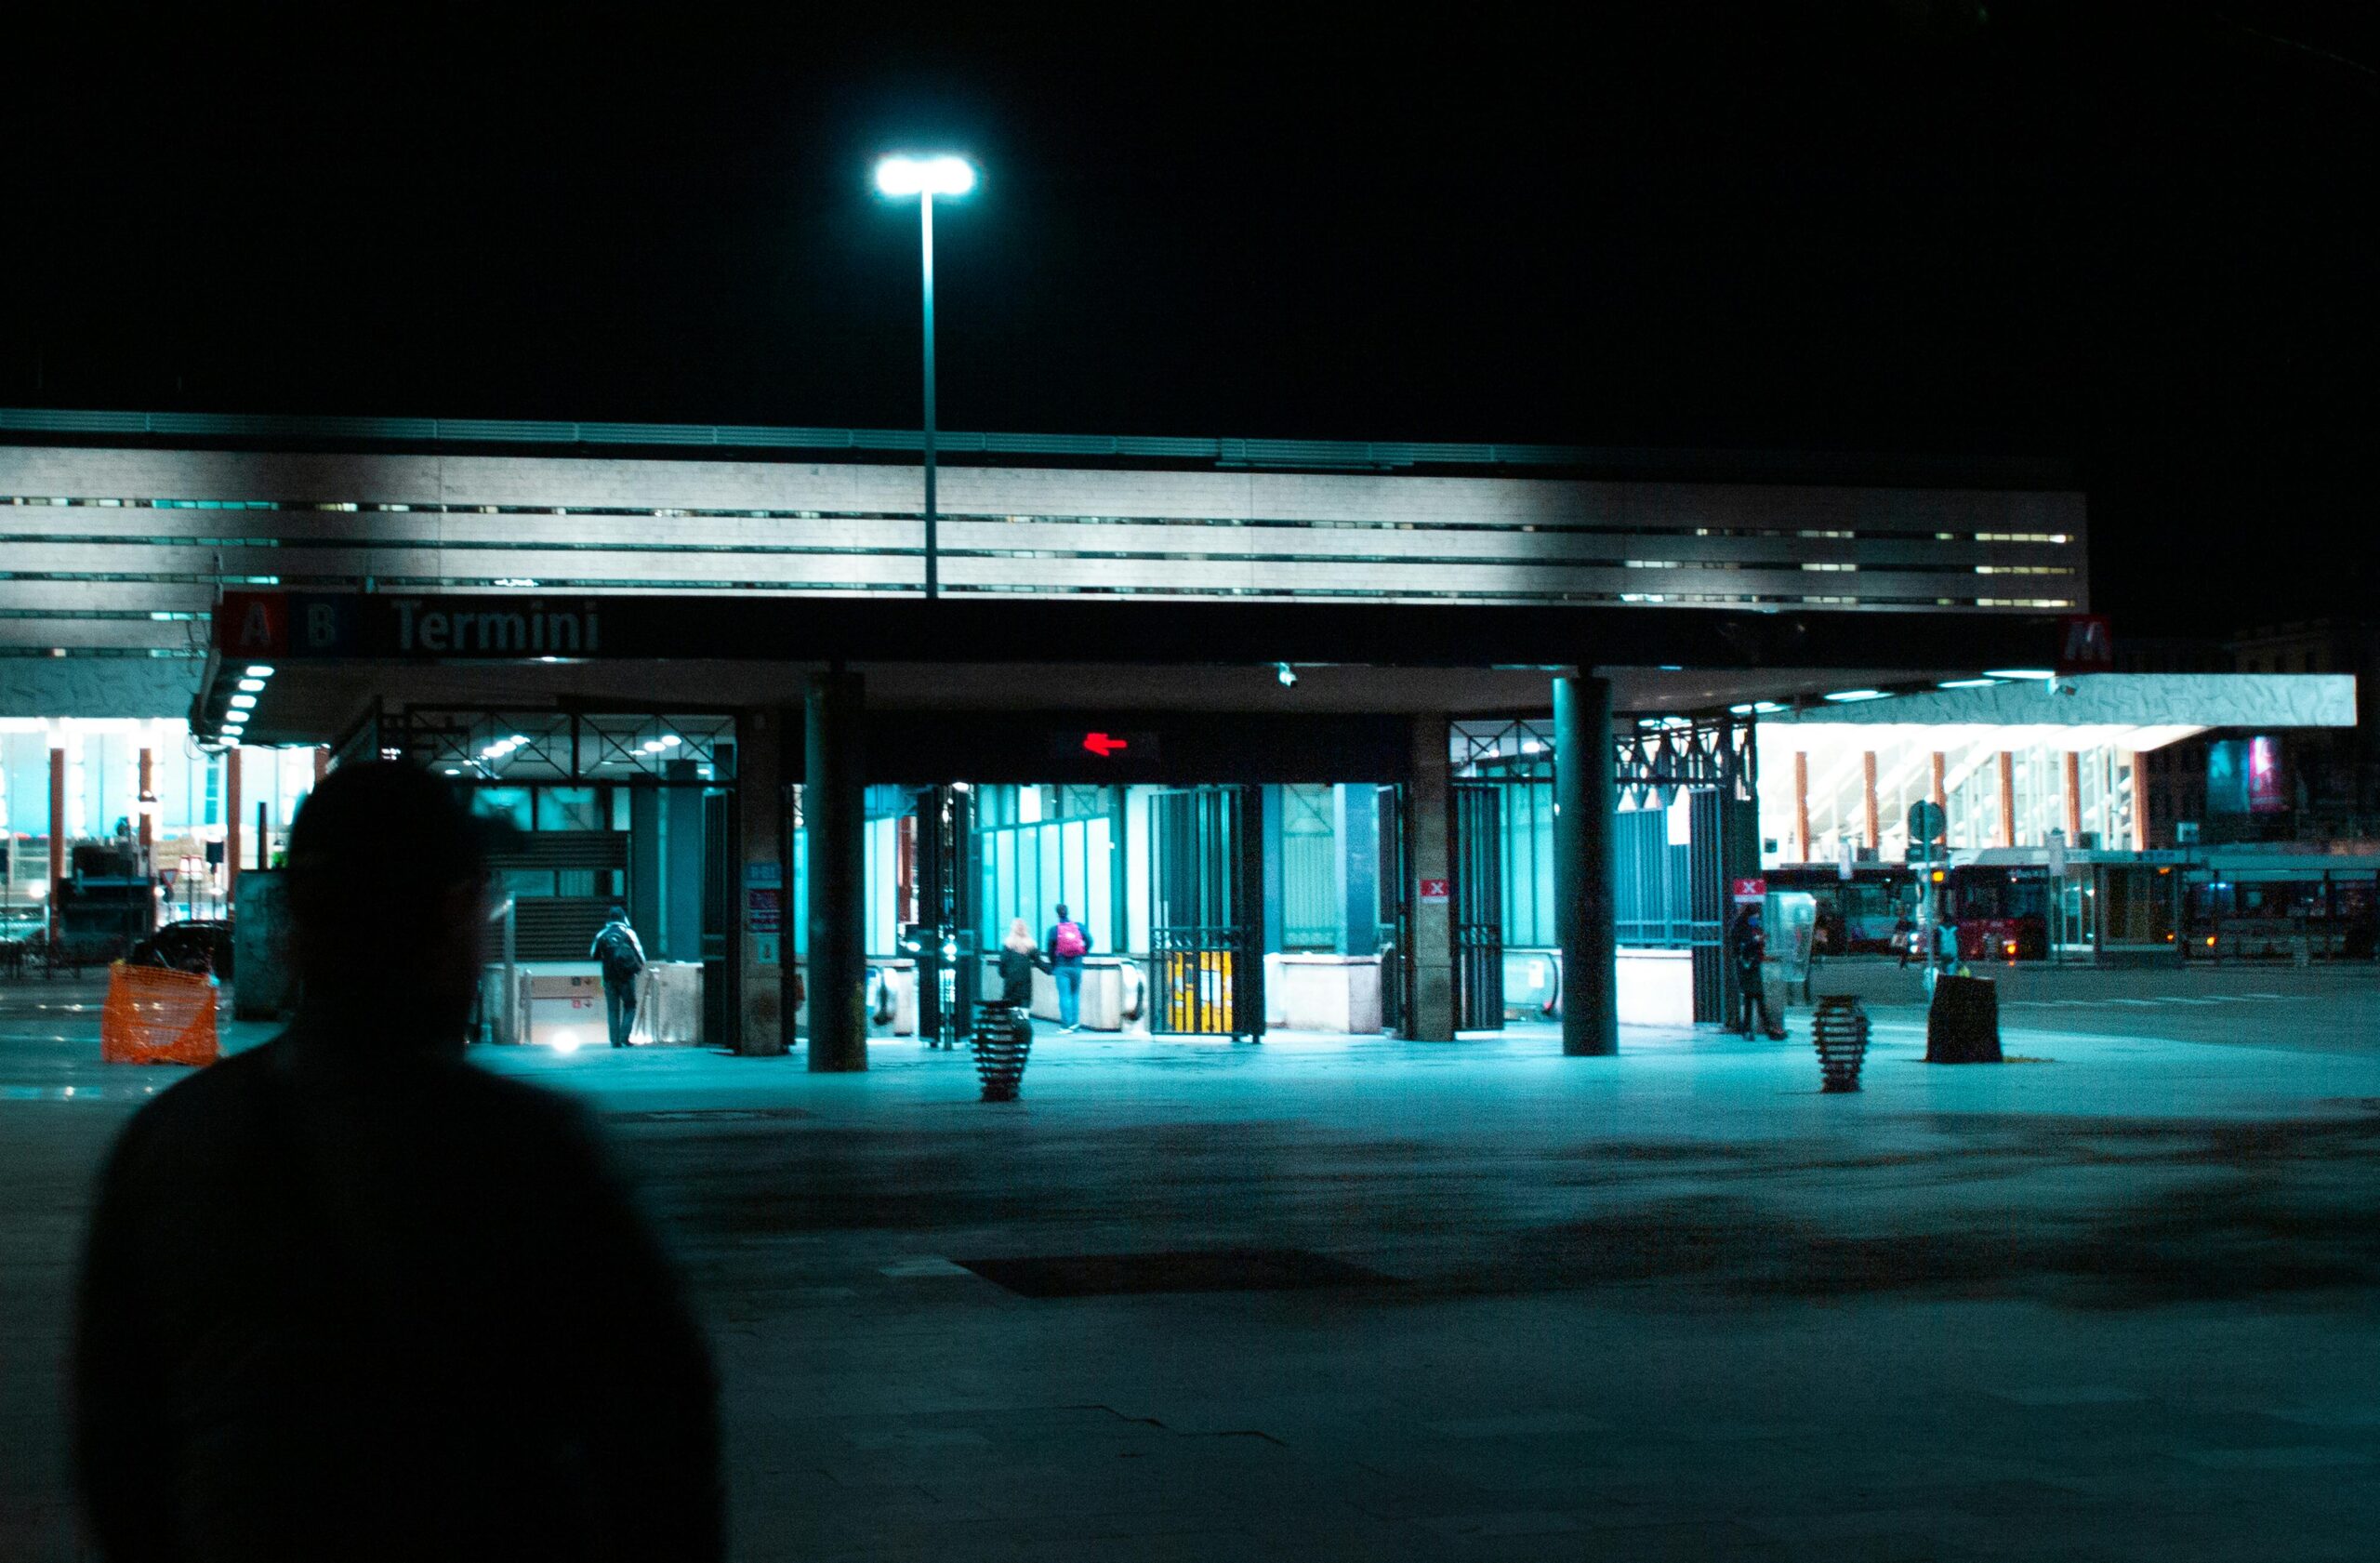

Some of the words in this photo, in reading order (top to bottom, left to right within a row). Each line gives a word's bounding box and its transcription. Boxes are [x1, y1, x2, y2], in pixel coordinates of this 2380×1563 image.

[239, 601, 271, 647] A
[306, 603, 337, 647] B
[390, 598, 601, 651] Termini
[2064, 621, 2113, 661] M
